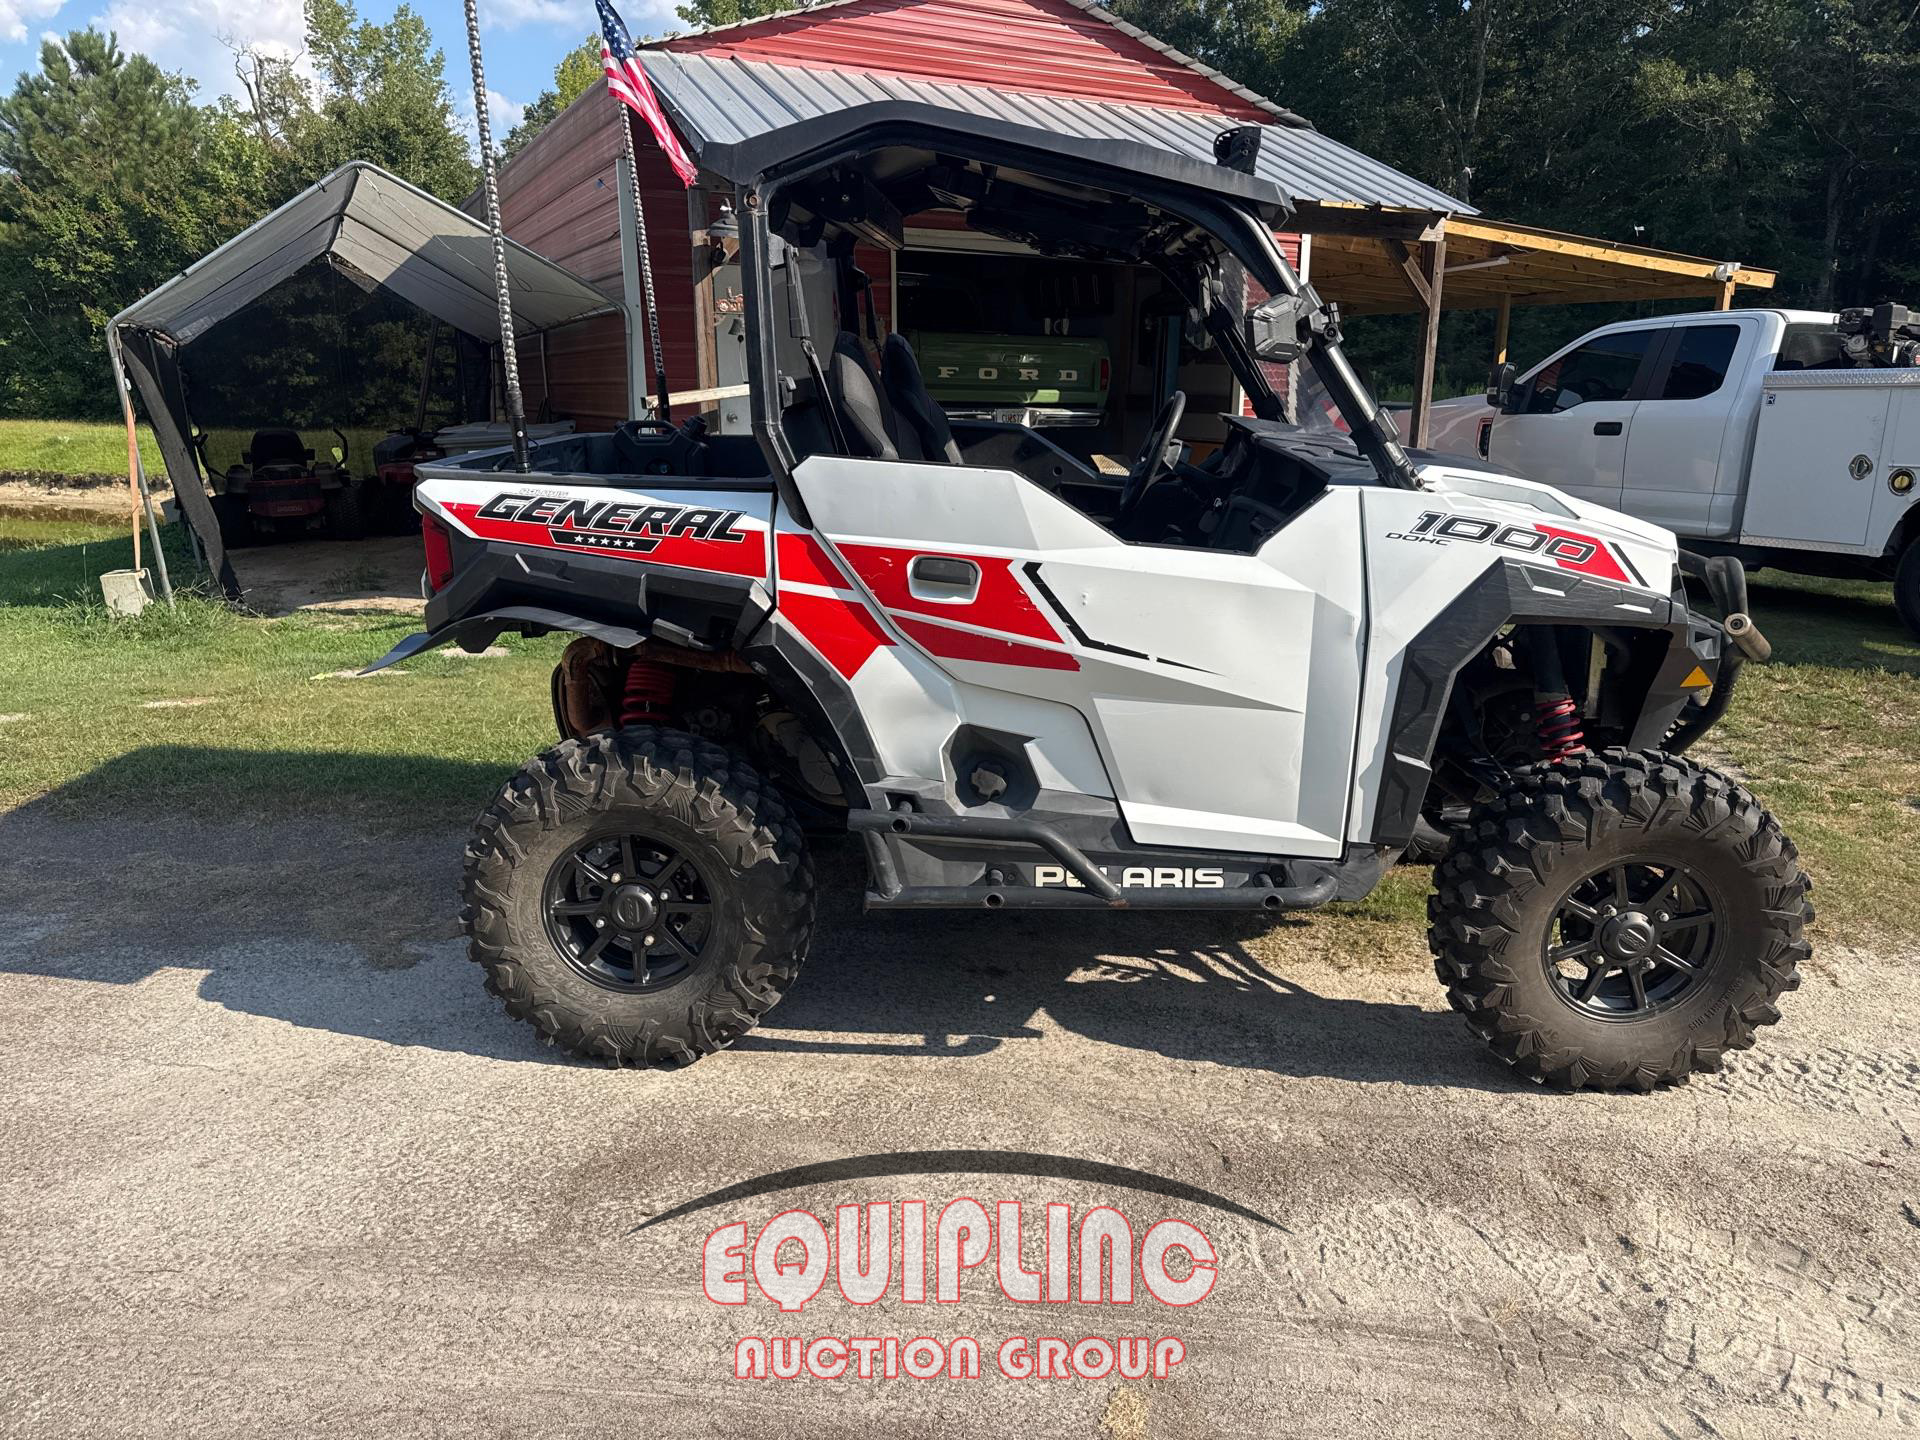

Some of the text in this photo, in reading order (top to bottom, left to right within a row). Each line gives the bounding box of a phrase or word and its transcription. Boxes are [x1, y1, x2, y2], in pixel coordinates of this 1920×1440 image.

[937, 366, 1078, 381] FORD
[474, 492, 748, 542] GENERAL
[1385, 531, 1453, 546] DOHC
[1409, 510, 1597, 565] 1000
[1035, 866, 1225, 888] PARIS
